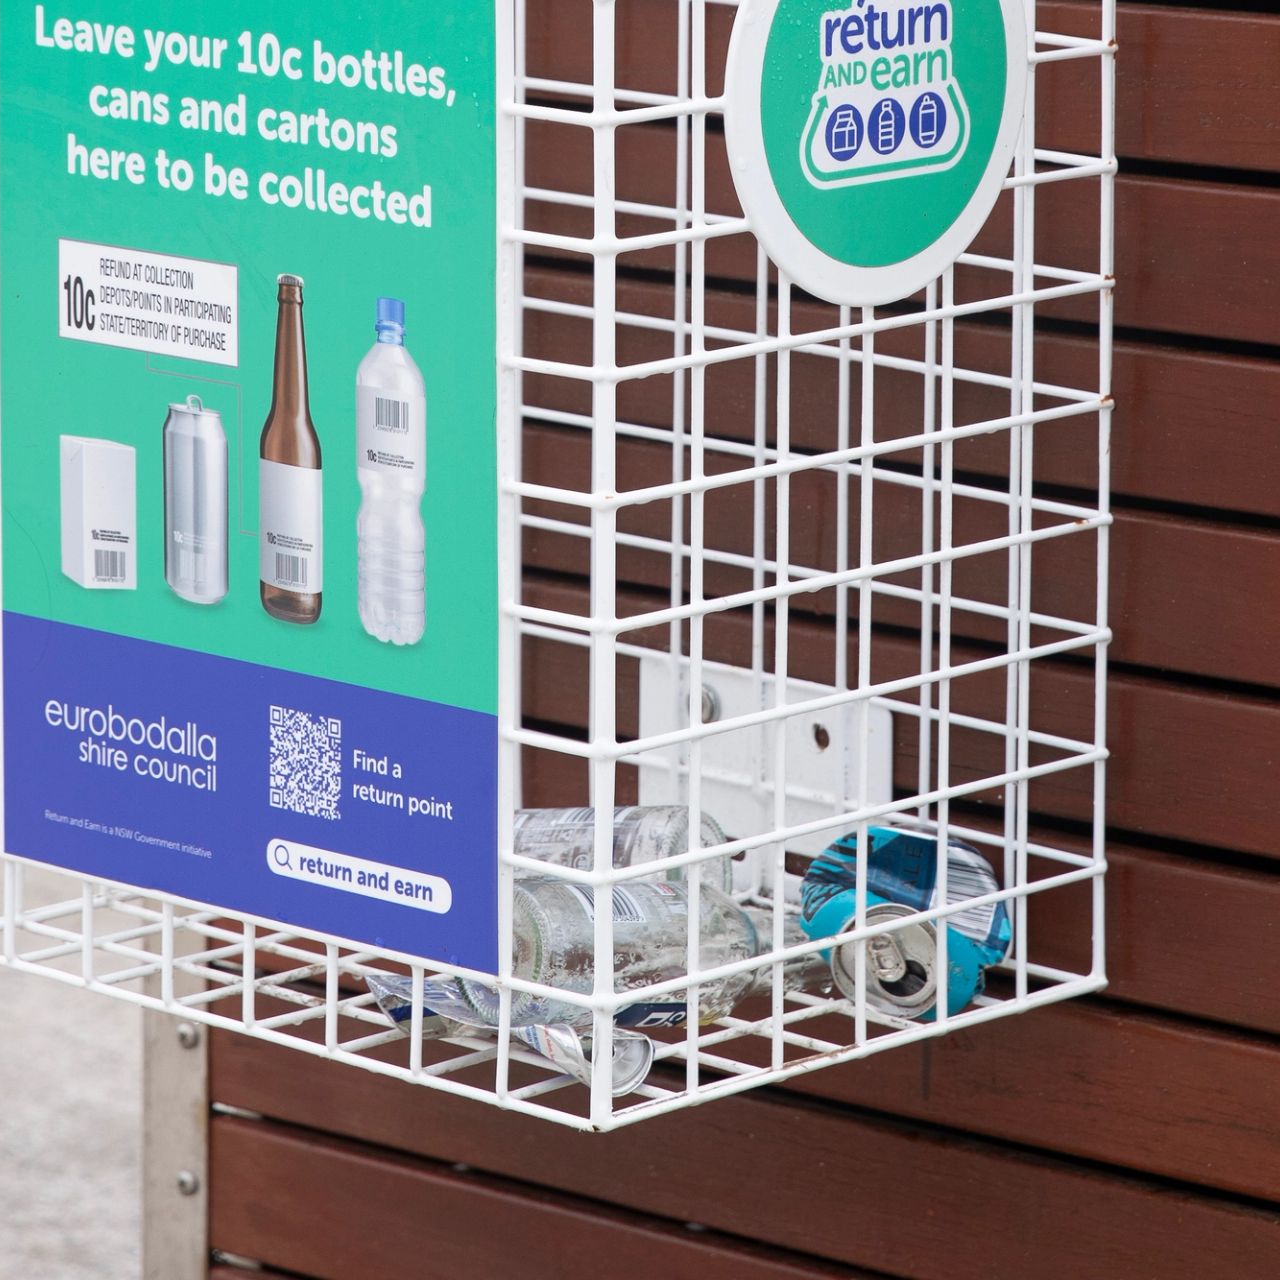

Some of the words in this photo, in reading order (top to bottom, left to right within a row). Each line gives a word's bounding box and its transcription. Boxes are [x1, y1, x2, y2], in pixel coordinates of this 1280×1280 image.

[825, 2, 948, 58] return
[35, 4, 135, 58] Leave
[144, 29, 228, 72] your
[237, 31, 303, 80] 10c
[313, 40, 457, 108] bottles,
[824, 59, 868, 90] AND
[870, 48, 948, 91] earn
[89, 84, 170, 126] cans
[179, 94, 246, 136] and
[257, 108, 398, 158] cartons
[67, 133, 146, 185] here
[155, 149, 194, 191] to
[204, 152, 249, 200] be
[258, 167, 432, 228] collected
[99, 257, 131, 280] REFUND
[132, 263, 143, 281] AT
[144, 265, 194, 290] COLLECTION
[64, 274, 95, 331] 10c
[100, 285, 162, 313] DEPOTS/POINTS
[164, 295, 172, 314] IN
[174, 297, 232, 324] PARTICIPATING
[99, 312, 169, 341] STATE/TERRITORY
[171, 325, 181, 343] OF
[184, 326, 226, 351] PURCHASE
[367, 449, 377, 463] 10c
[45, 699, 217, 762] eurobodalla
[79, 736, 128, 771] shire
[134, 754, 217, 792] council
[353, 749, 388, 776] Find
[392, 762, 402, 779] a
[353, 783, 404, 809] return
[408, 796, 453, 821] point
[44, 809, 69, 824] Return
[70, 817, 83, 828] and
[84, 819, 100, 832] Earn
[115, 827, 133, 840] NSW
[134, 831, 180, 851] Government
[181, 843, 212, 859] initiative
[299, 855, 352, 883] return
[357, 871, 389, 891] and
[394, 878, 433, 902] earn
